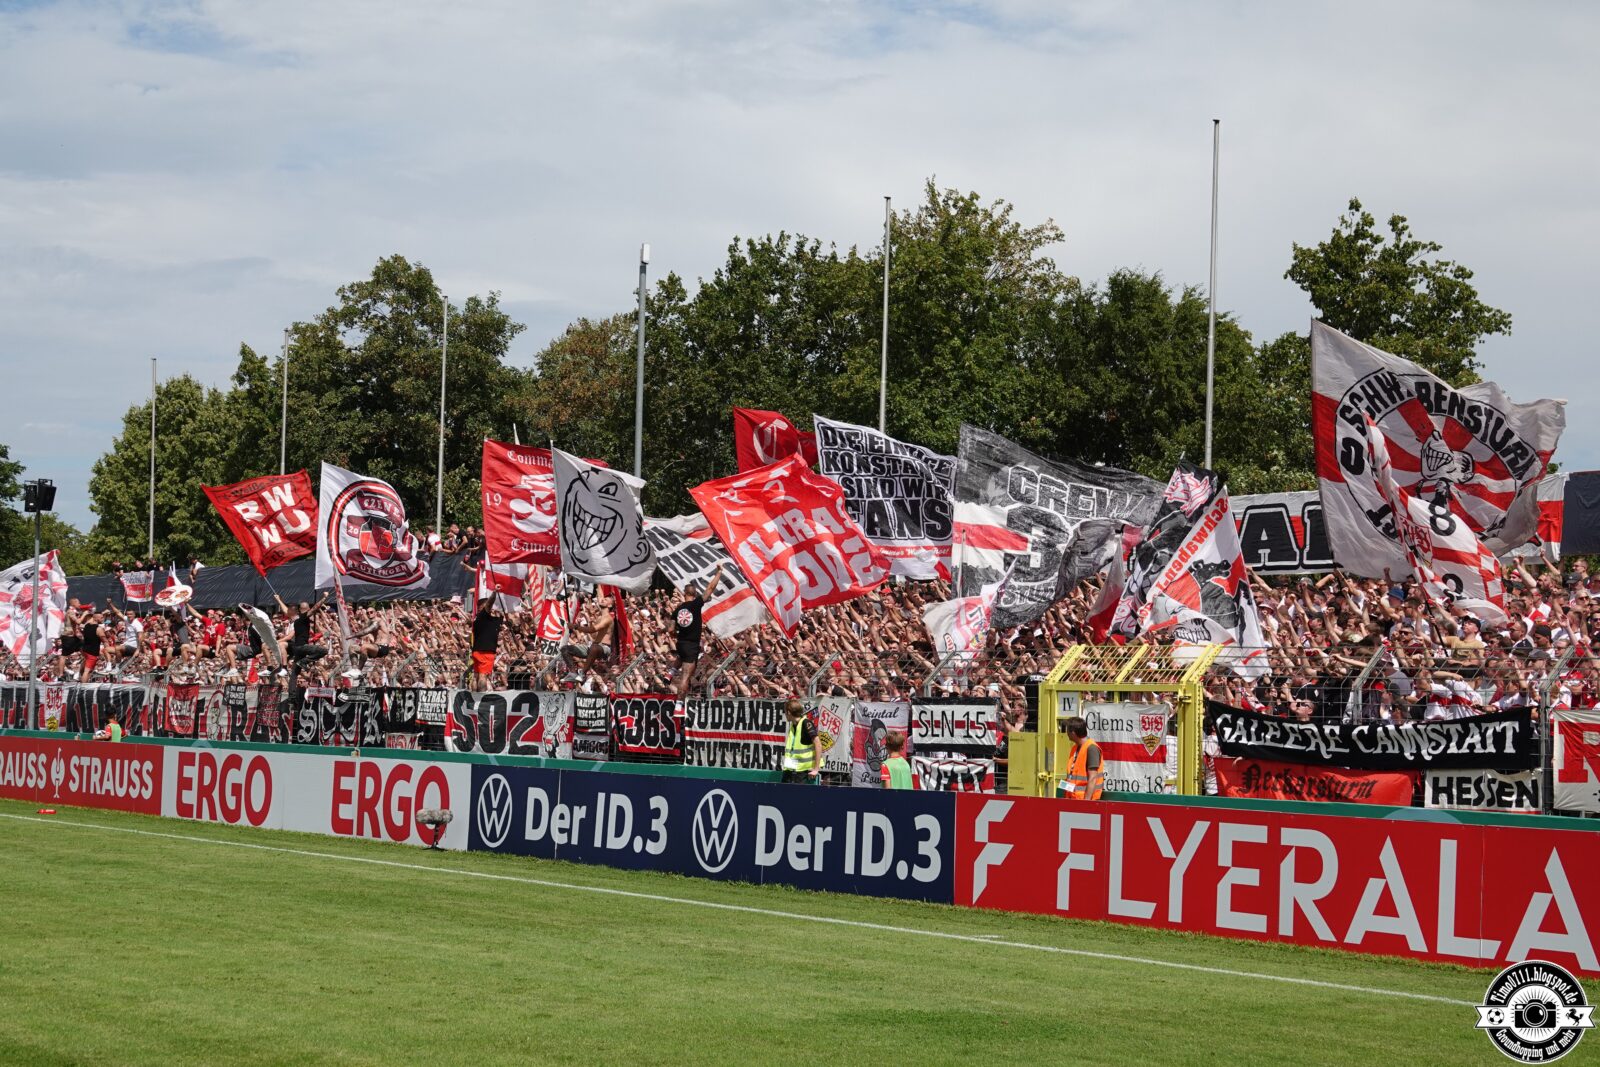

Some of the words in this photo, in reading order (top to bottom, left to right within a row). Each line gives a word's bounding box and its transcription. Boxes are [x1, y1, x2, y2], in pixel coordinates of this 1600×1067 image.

[821, 424, 863, 453] DIE
[485, 492, 502, 506] 19
[839, 476, 896, 500] SIND
[1007, 465, 1145, 520] CREW
[862, 706, 899, 719] Leintal
[1063, 697, 1074, 711] IV
[918, 710, 955, 739] SLN
[963, 711, 987, 740] 15
[1085, 711, 1134, 732] Glems
[685, 739, 786, 771] STUTTGART
[1351, 720, 1520, 761] CANNSTATT
[69, 755, 153, 800] STRAUSS
[176, 751, 273, 827] ERGO
[1431, 775, 1538, 809] HESSEN
[331, 760, 450, 846] ERGO
[525, 786, 586, 846] Der
[594, 791, 669, 856] ID.3
[755, 804, 832, 873] Der
[844, 810, 941, 883] ID.3
